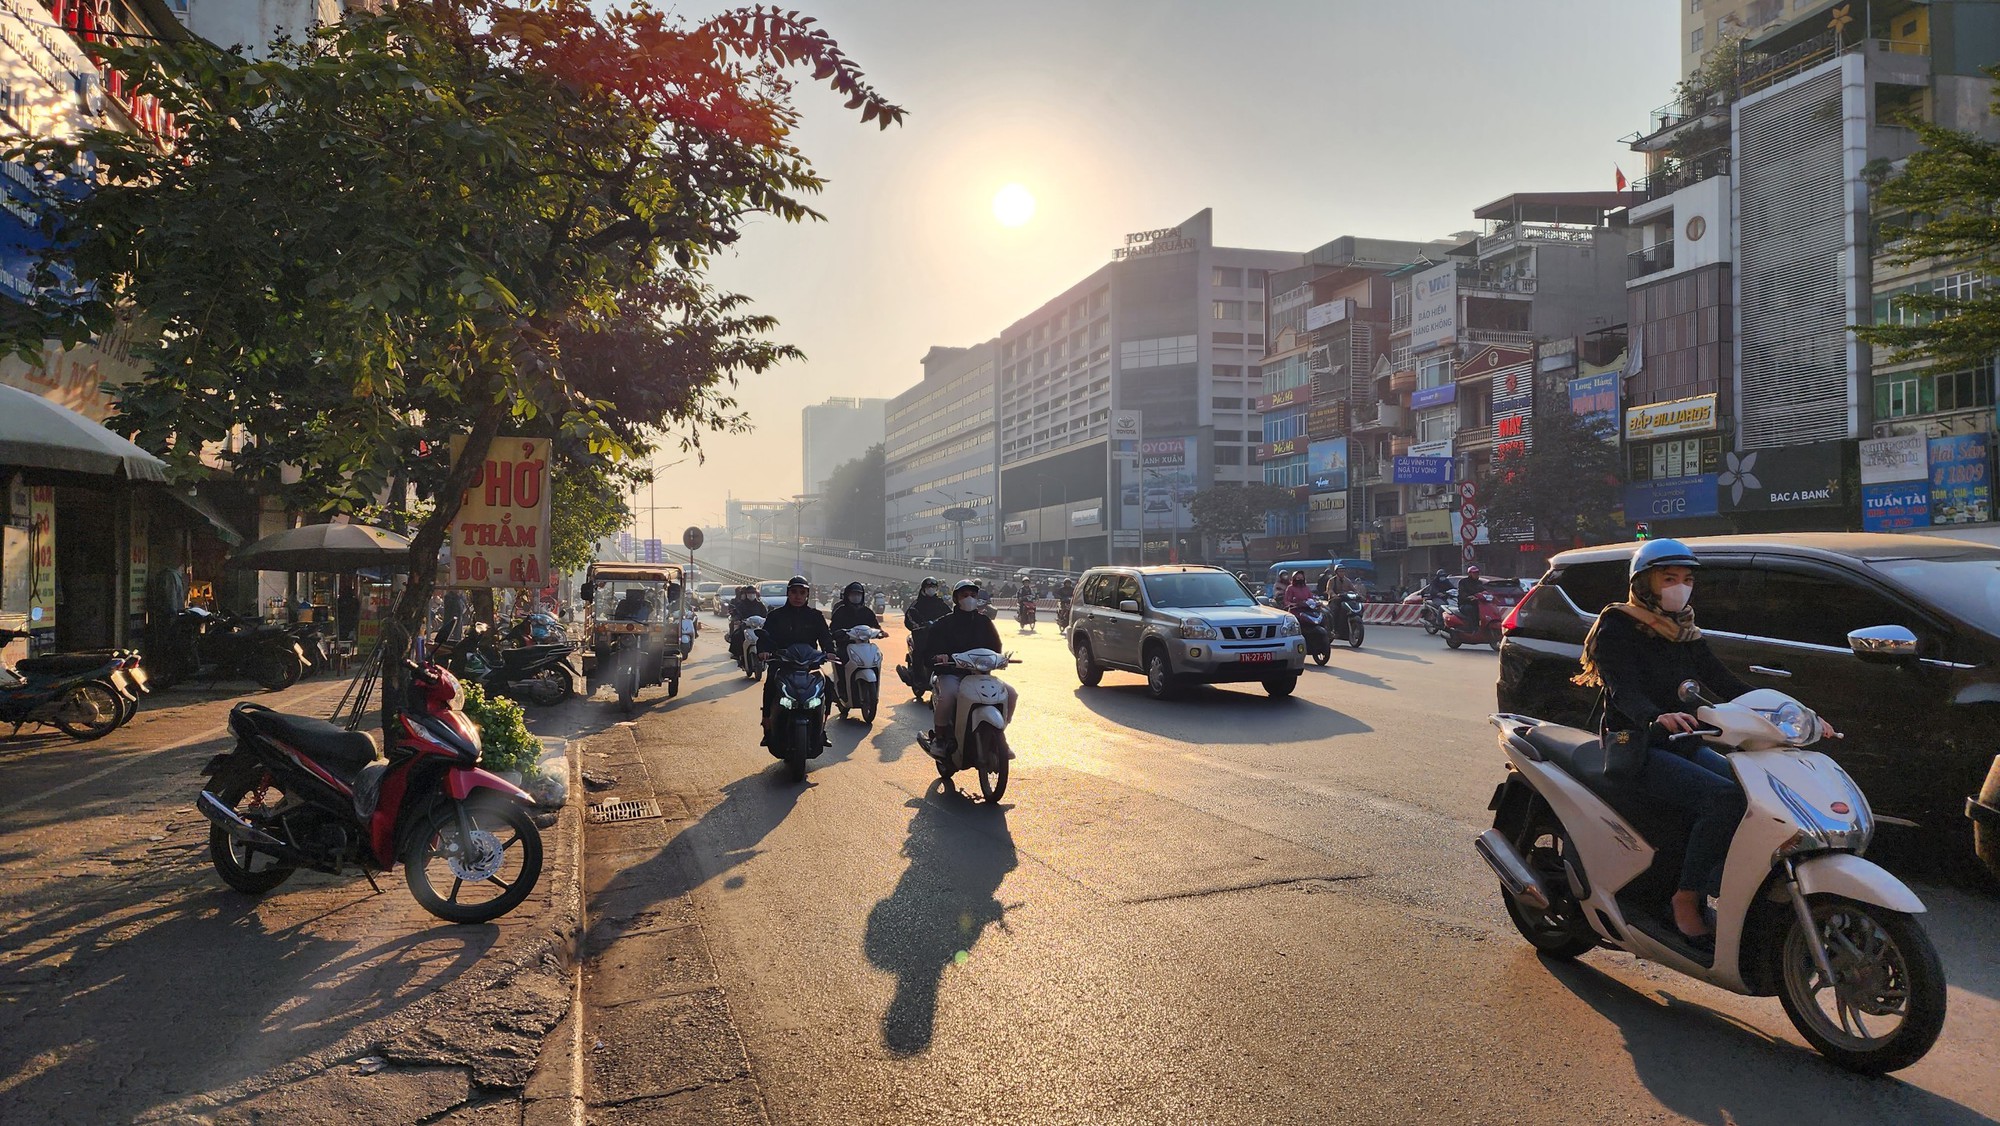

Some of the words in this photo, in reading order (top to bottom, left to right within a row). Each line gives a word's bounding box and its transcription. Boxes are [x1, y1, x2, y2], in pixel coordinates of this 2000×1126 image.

[1126, 227, 1180, 244] TOYOTA
[1113, 244, 1155, 259] THANH
[1430, 318, 1452, 332] KHÔNG
[1653, 405, 1712, 427] BILLIARDS
[1686, 461, 1698, 469] 39K
[1948, 463, 1984, 484] 1809
[1770, 492, 1791, 503] BAC
[1791, 491, 1800, 501] A
[1801, 489, 1830, 500] BANK
[1866, 493, 1903, 508] TUẤN
[1904, 493, 1927, 505] TÀI
[1652, 497, 1686, 514] care
[461, 513, 537, 548] THẮM
[455, 551, 487, 581] BÒ
[510, 554, 541, 582] GÀ
